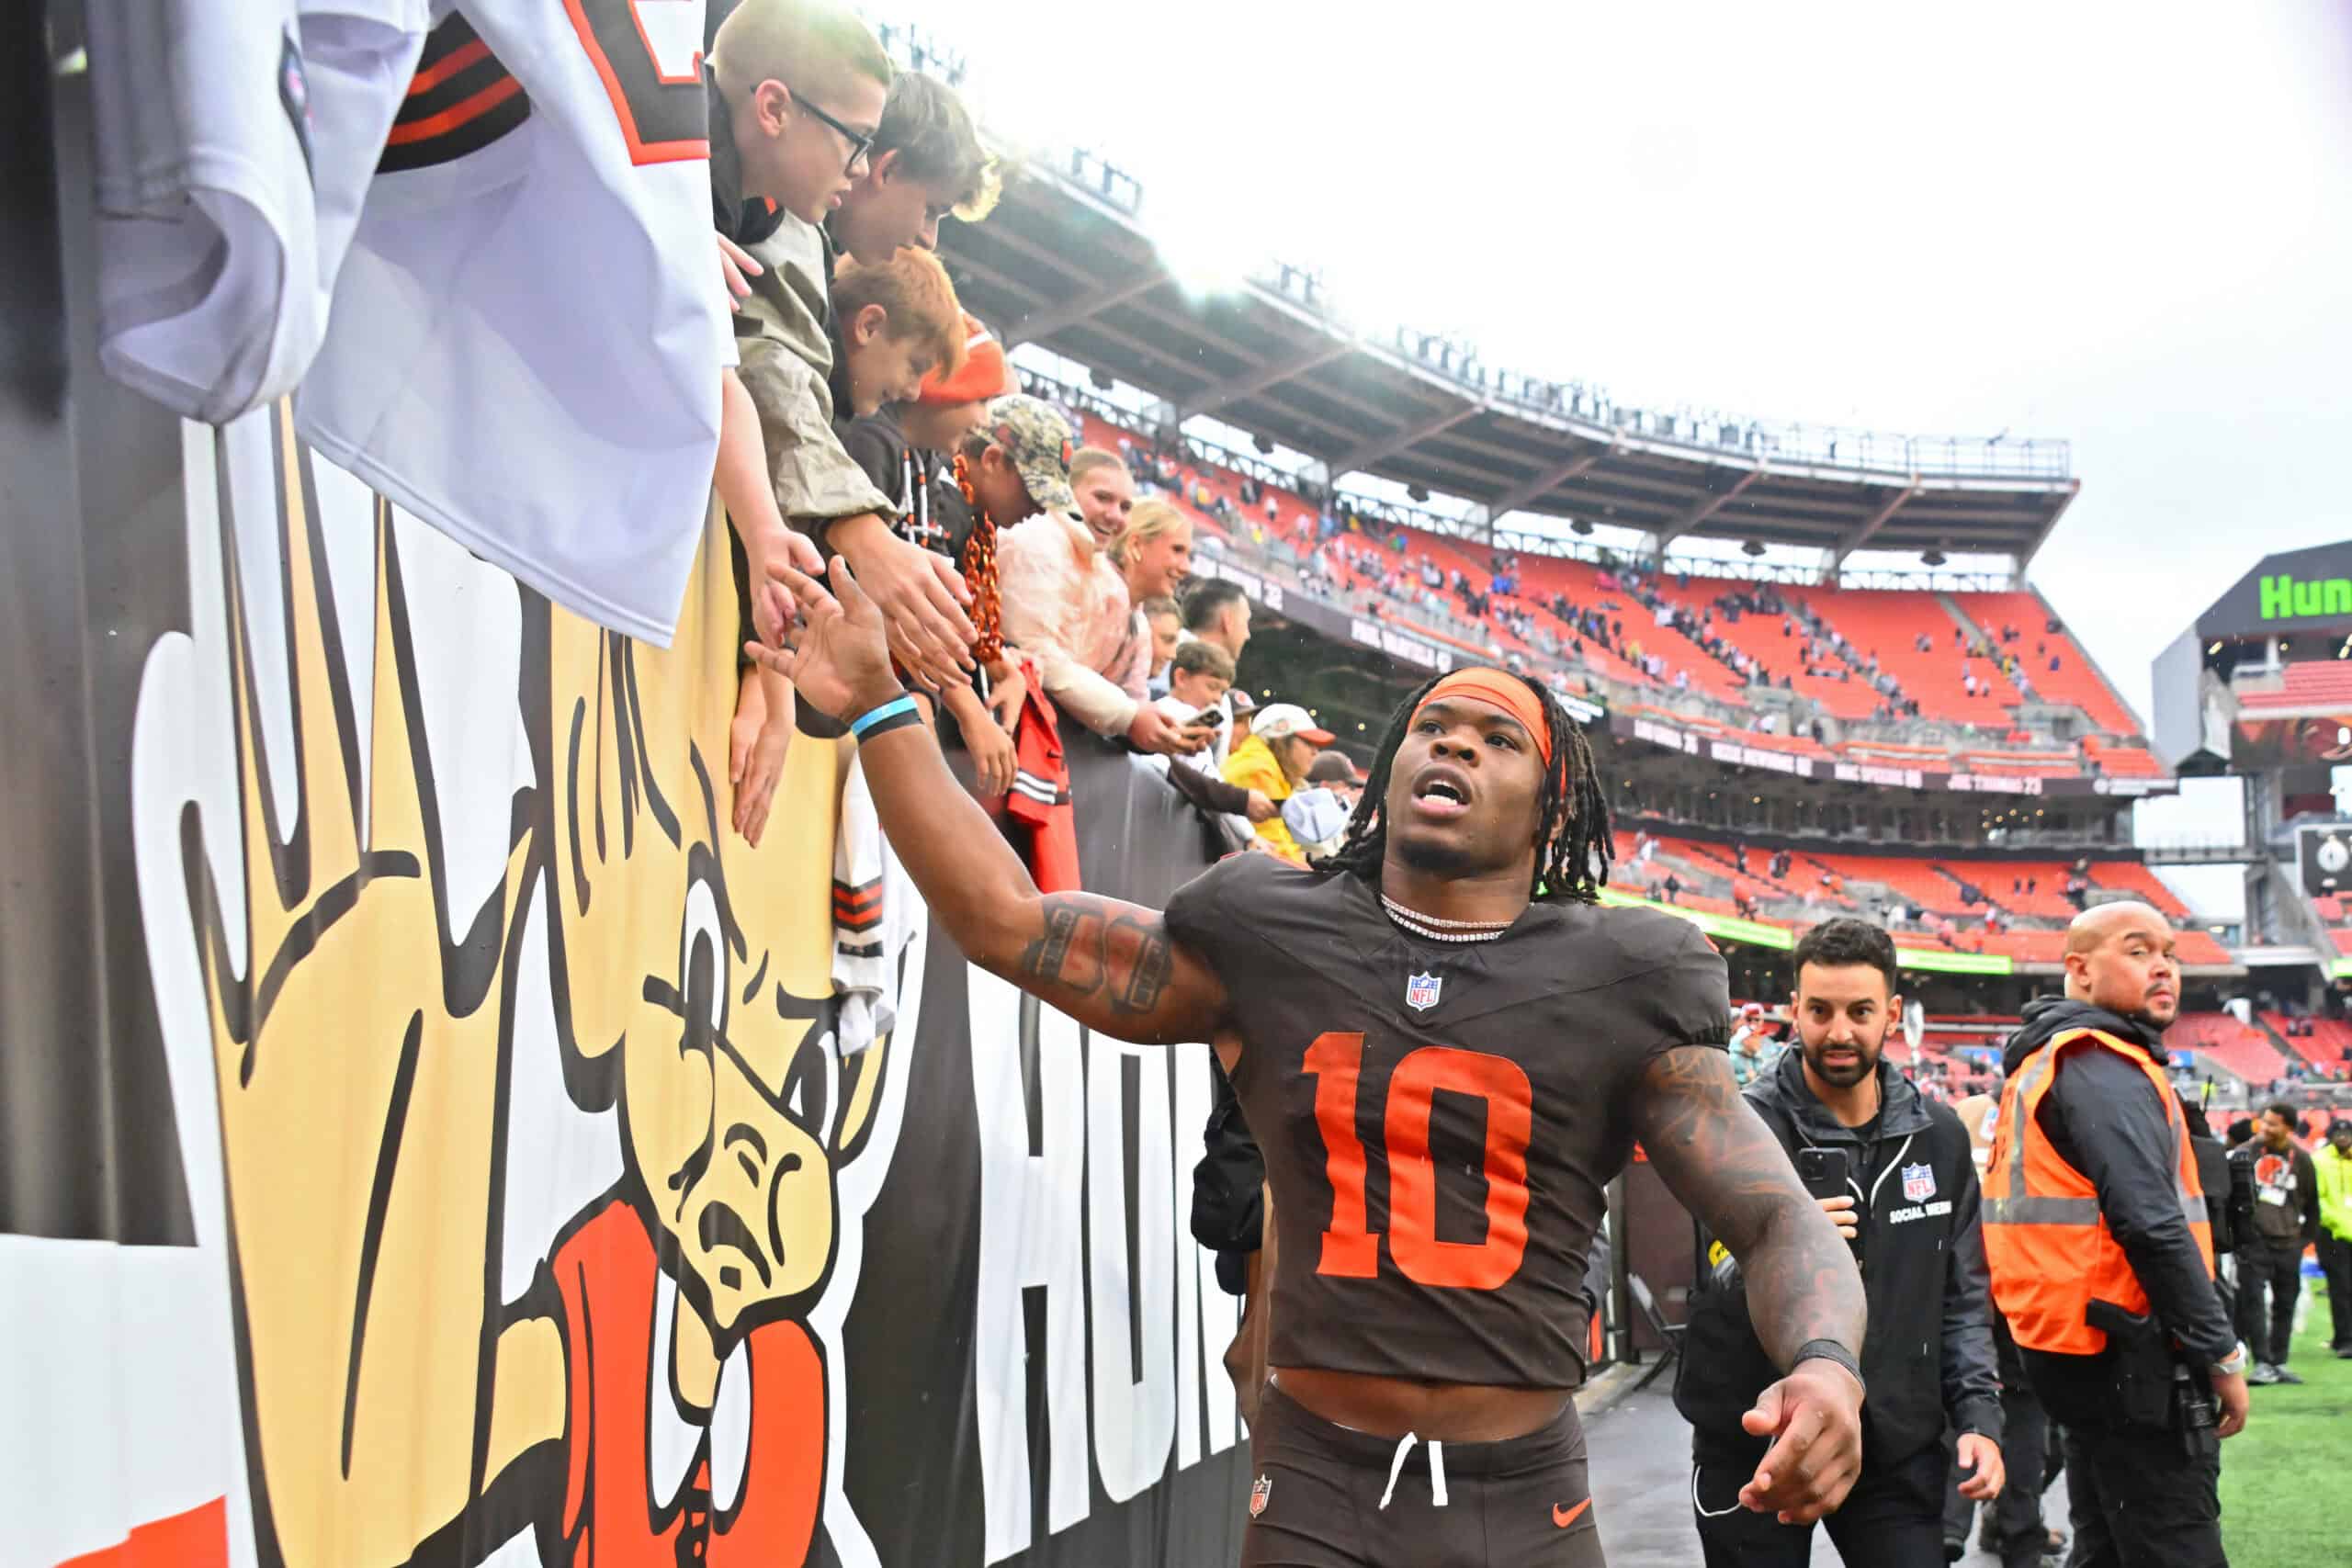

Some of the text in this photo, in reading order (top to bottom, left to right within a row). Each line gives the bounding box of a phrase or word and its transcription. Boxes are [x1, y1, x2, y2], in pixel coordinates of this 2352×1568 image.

[2260, 573, 2352, 620] Hun
[1411, 988, 1436, 1003] NFL
[1302, 1032, 1533, 1291] 10
[1906, 1179, 1932, 1198] NFL
[1889, 1205, 1926, 1224] SOCIAL
